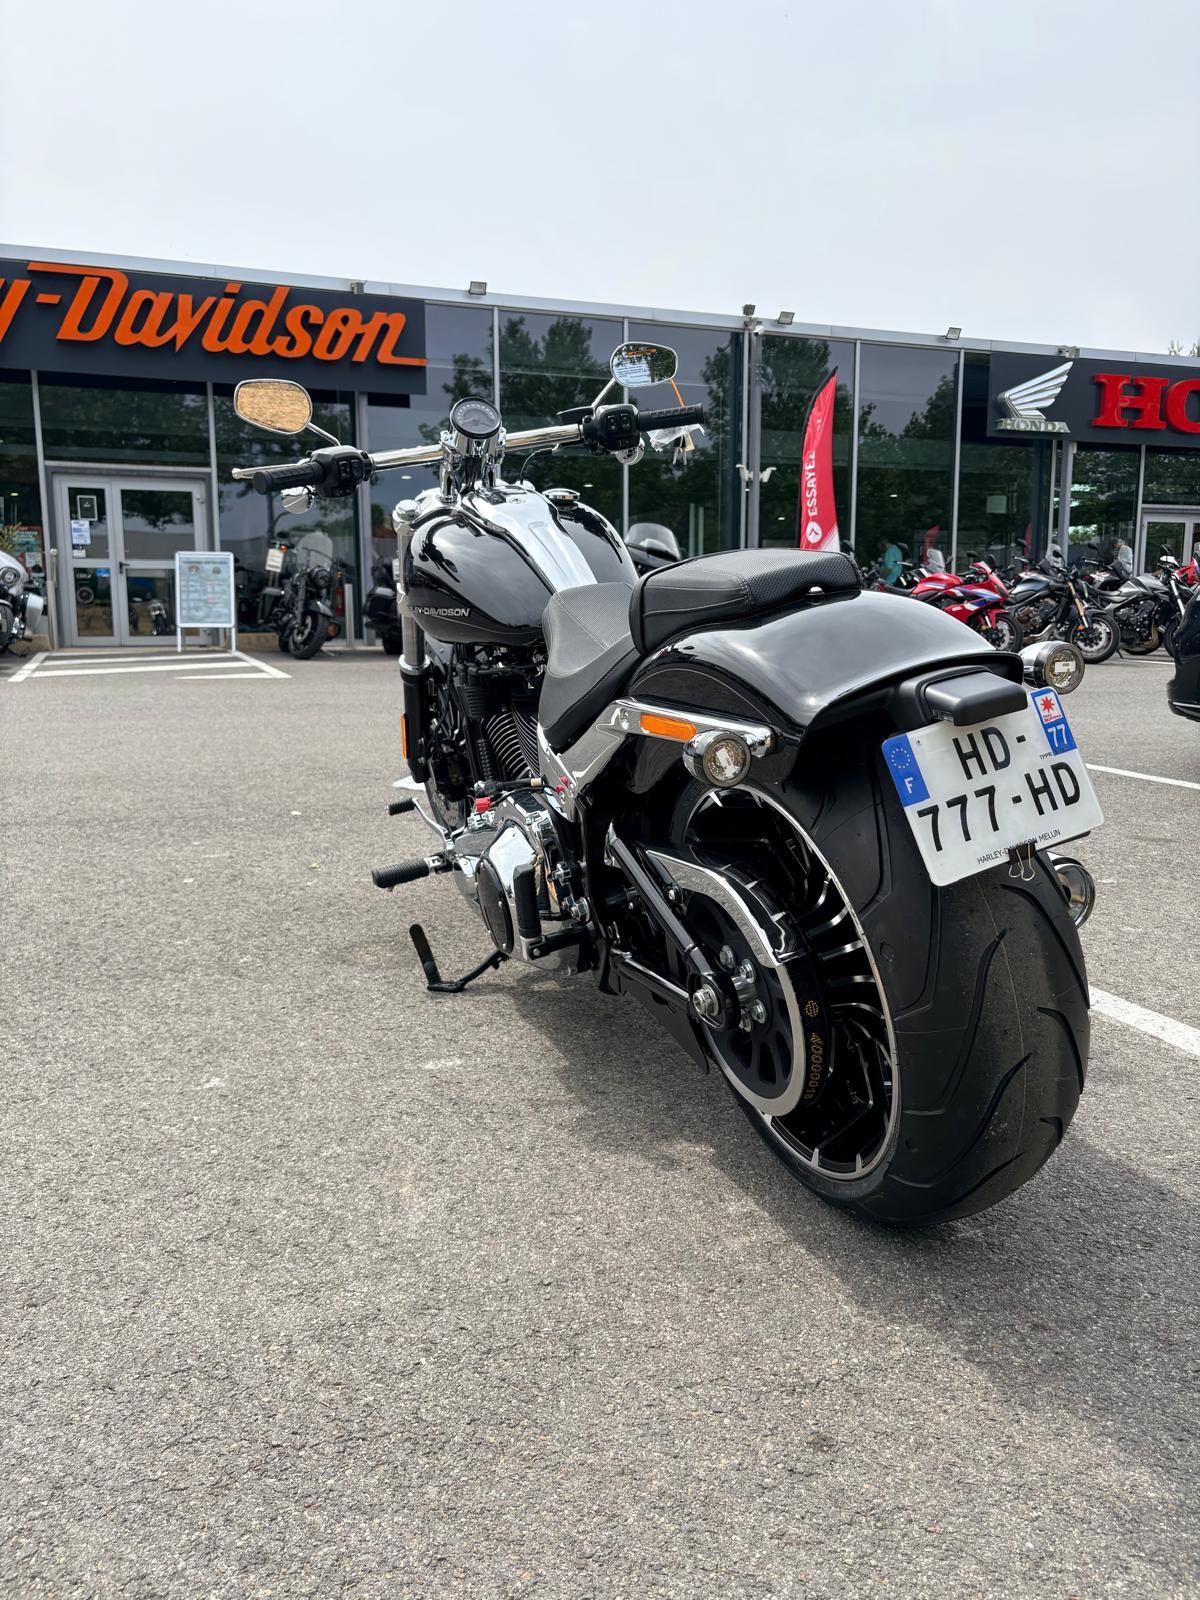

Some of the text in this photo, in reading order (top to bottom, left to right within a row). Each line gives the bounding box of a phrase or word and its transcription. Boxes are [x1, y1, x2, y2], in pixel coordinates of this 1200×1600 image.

[995, 419, 1071, 433] HONDA
[1048, 724, 1067, 747] 77
[904, 776, 914, 795] F
[1038, 828, 1061, 842] MELUN
